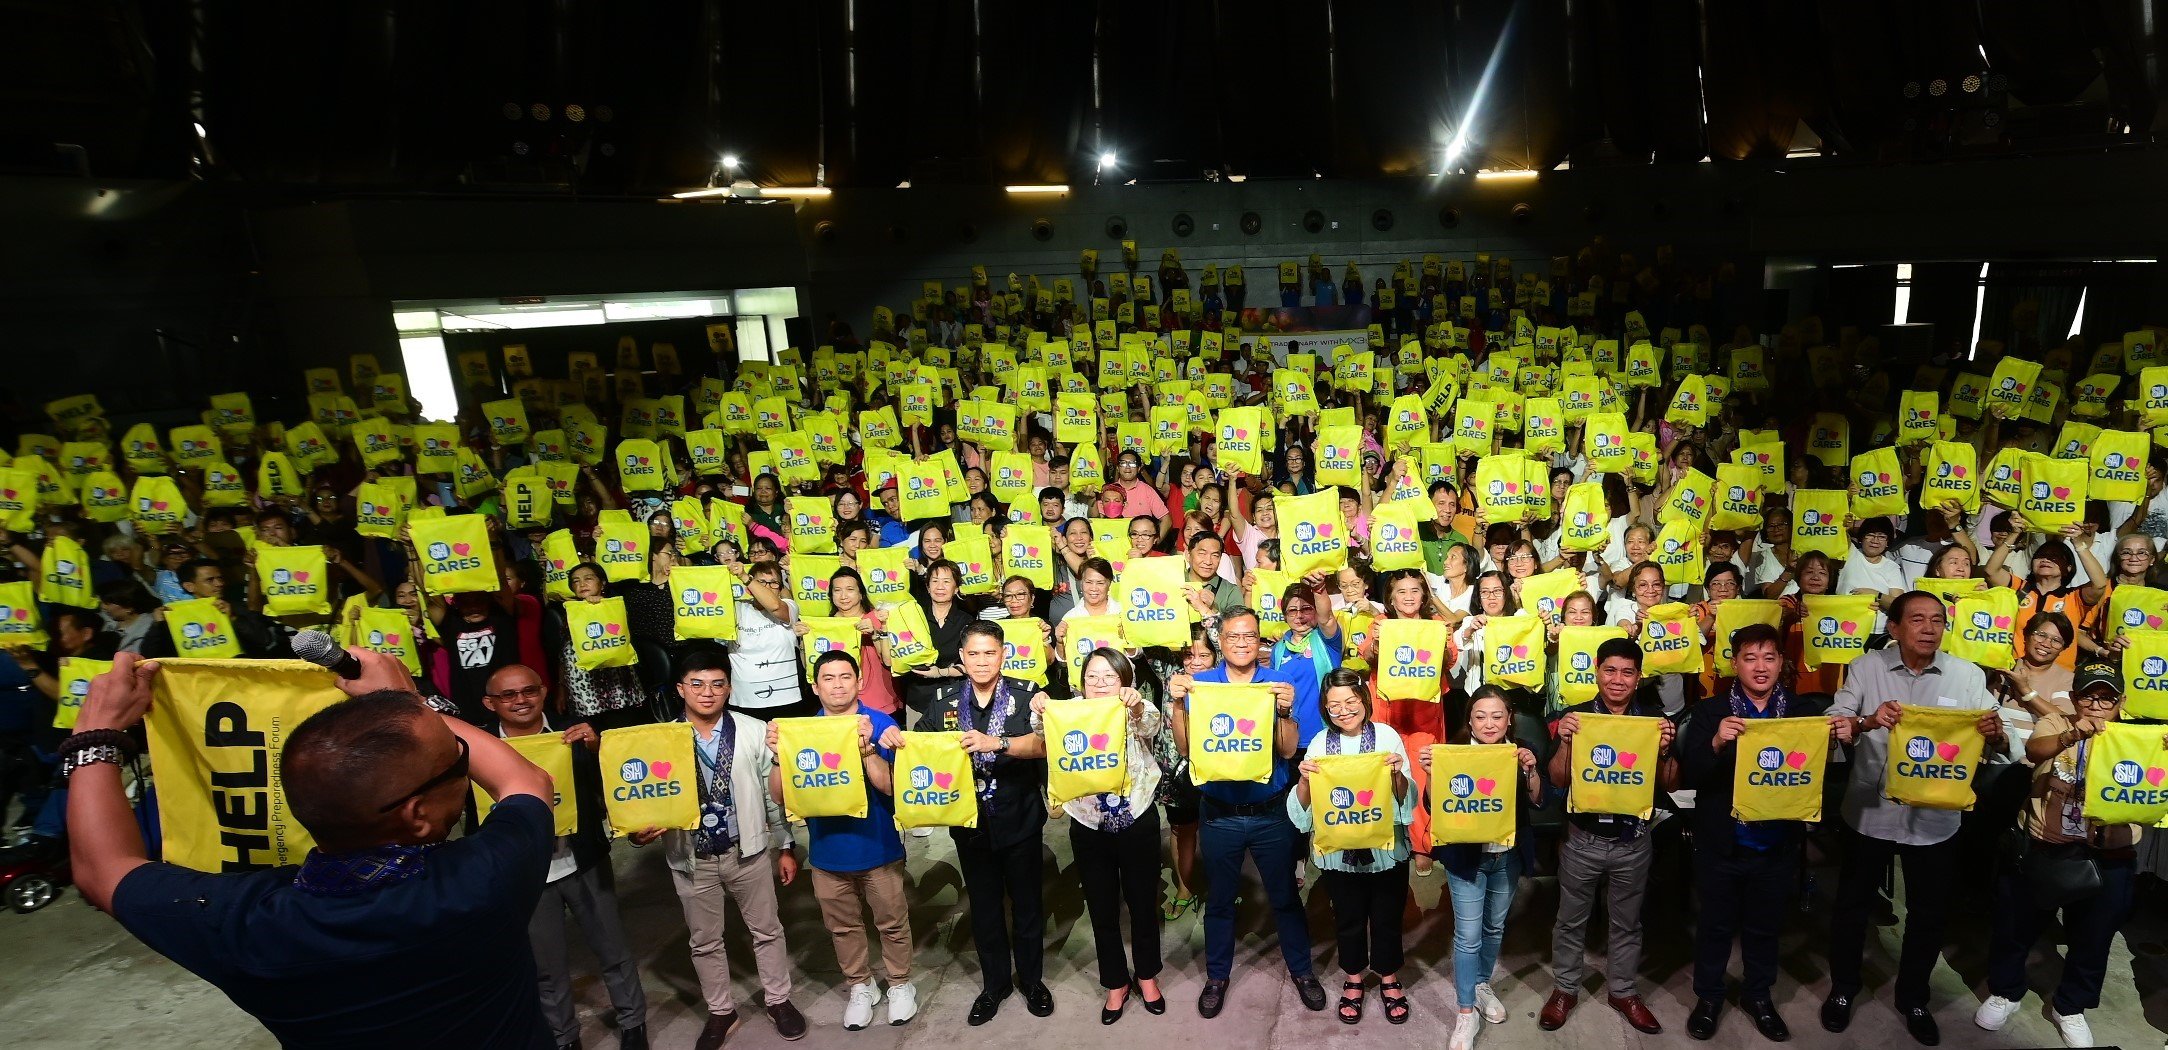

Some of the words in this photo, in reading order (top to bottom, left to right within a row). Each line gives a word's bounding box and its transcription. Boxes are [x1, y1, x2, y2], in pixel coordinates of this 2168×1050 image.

[1346, 371, 1368, 379] CARES
[1629, 368, 1653, 377] CARES
[1737, 371, 1761, 379] CARES
[1490, 376, 1510, 384] CARES
[775, 384, 794, 392] CARES
[1285, 393, 1311, 402] CARES
[1430, 383, 1452, 411] HELP
[1992, 389, 2021, 402] CARES
[2080, 395, 2106, 403] CARES
[903, 404, 928, 412] CARES
[1566, 401, 1593, 409] CARES
[1672, 402, 1699, 411] CARES
[2146, 400, 2168, 408] CAR
[656, 418, 679, 427] CARES
[726, 413, 750, 421] CARES
[1063, 418, 1091, 426] CARES
[757, 421, 784, 429] CARES
[1395, 421, 1425, 431] CARES
[1905, 420, 1935, 428] CARES
[864, 429, 890, 438] CARES
[980, 427, 1007, 437] CARES
[1155, 431, 1182, 440] CARES
[1457, 429, 1487, 439] CARES
[1527, 428, 1557, 437] CARES
[364, 442, 395, 454] CARES
[811, 443, 837, 452] CARES
[1218, 442, 1250, 451] CARES
[424, 449, 455, 457] CARES
[1592, 448, 1626, 457] CARES
[692, 456, 720, 464] CARES
[780, 457, 810, 468] CARES
[1319, 460, 1354, 470] CARES
[623, 467, 655, 475] CARES
[1634, 462, 1652, 470] RES
[460, 469, 487, 485] CARES
[1072, 470, 1099, 478] CARES
[2095, 469, 2139, 481] CARES
[995, 480, 1026, 488] CARES
[1929, 478, 1971, 490] CARES
[1986, 480, 2020, 493] CARE
[552, 490, 571, 498] RES
[906, 488, 940, 500] CARES
[1859, 484, 1898, 498] CARES
[517, 483, 532, 523] HELP
[1486, 496, 1523, 506] CARES
[2025, 499, 2075, 513] CARES
[1672, 499, 1702, 520] CARES
[1722, 501, 1758, 514] CARES
[357, 514, 396, 526] CARES
[794, 527, 826, 535] CARES
[1567, 525, 1602, 539] CARES
[1797, 525, 1838, 536] CARES
[1291, 538, 1340, 555] CARES
[1376, 542, 1418, 553] CARES
[601, 552, 642, 563] CARES
[1657, 552, 1694, 565] CARES
[426, 557, 480, 574] CARES
[1008, 559, 1043, 568] CARES
[267, 584, 317, 595] CARES
[867, 583, 905, 593] CARES
[798, 592, 829, 601] CARE
[677, 606, 724, 617] CARES
[1127, 609, 1175, 622] CARES
[182, 635, 227, 650] CARES
[582, 635, 626, 651] CARES
[1643, 637, 1690, 652] CARES
[1812, 637, 1862, 649] CARES
[1001, 659, 1036, 669] ARES
[1490, 660, 1535, 675] CARES
[1389, 665, 1436, 678] CARES
[1564, 672, 1597, 684] CAR
[2133, 677, 2168, 690] CAR
[269, 716, 280, 750] Forum
[1203, 739, 1262, 752] CARES
[1058, 753, 1119, 771] CARES
[1582, 768, 1643, 785] CARES
[1897, 762, 1967, 780] CARES
[792, 770, 850, 788] CARES
[1748, 771, 1811, 786] CARES
[206, 702, 274, 872] HELP
[613, 781, 681, 801] CARES
[902, 788, 960, 806] CARES
[1442, 798, 1503, 813] CARES
[1324, 807, 1382, 826] CARES
